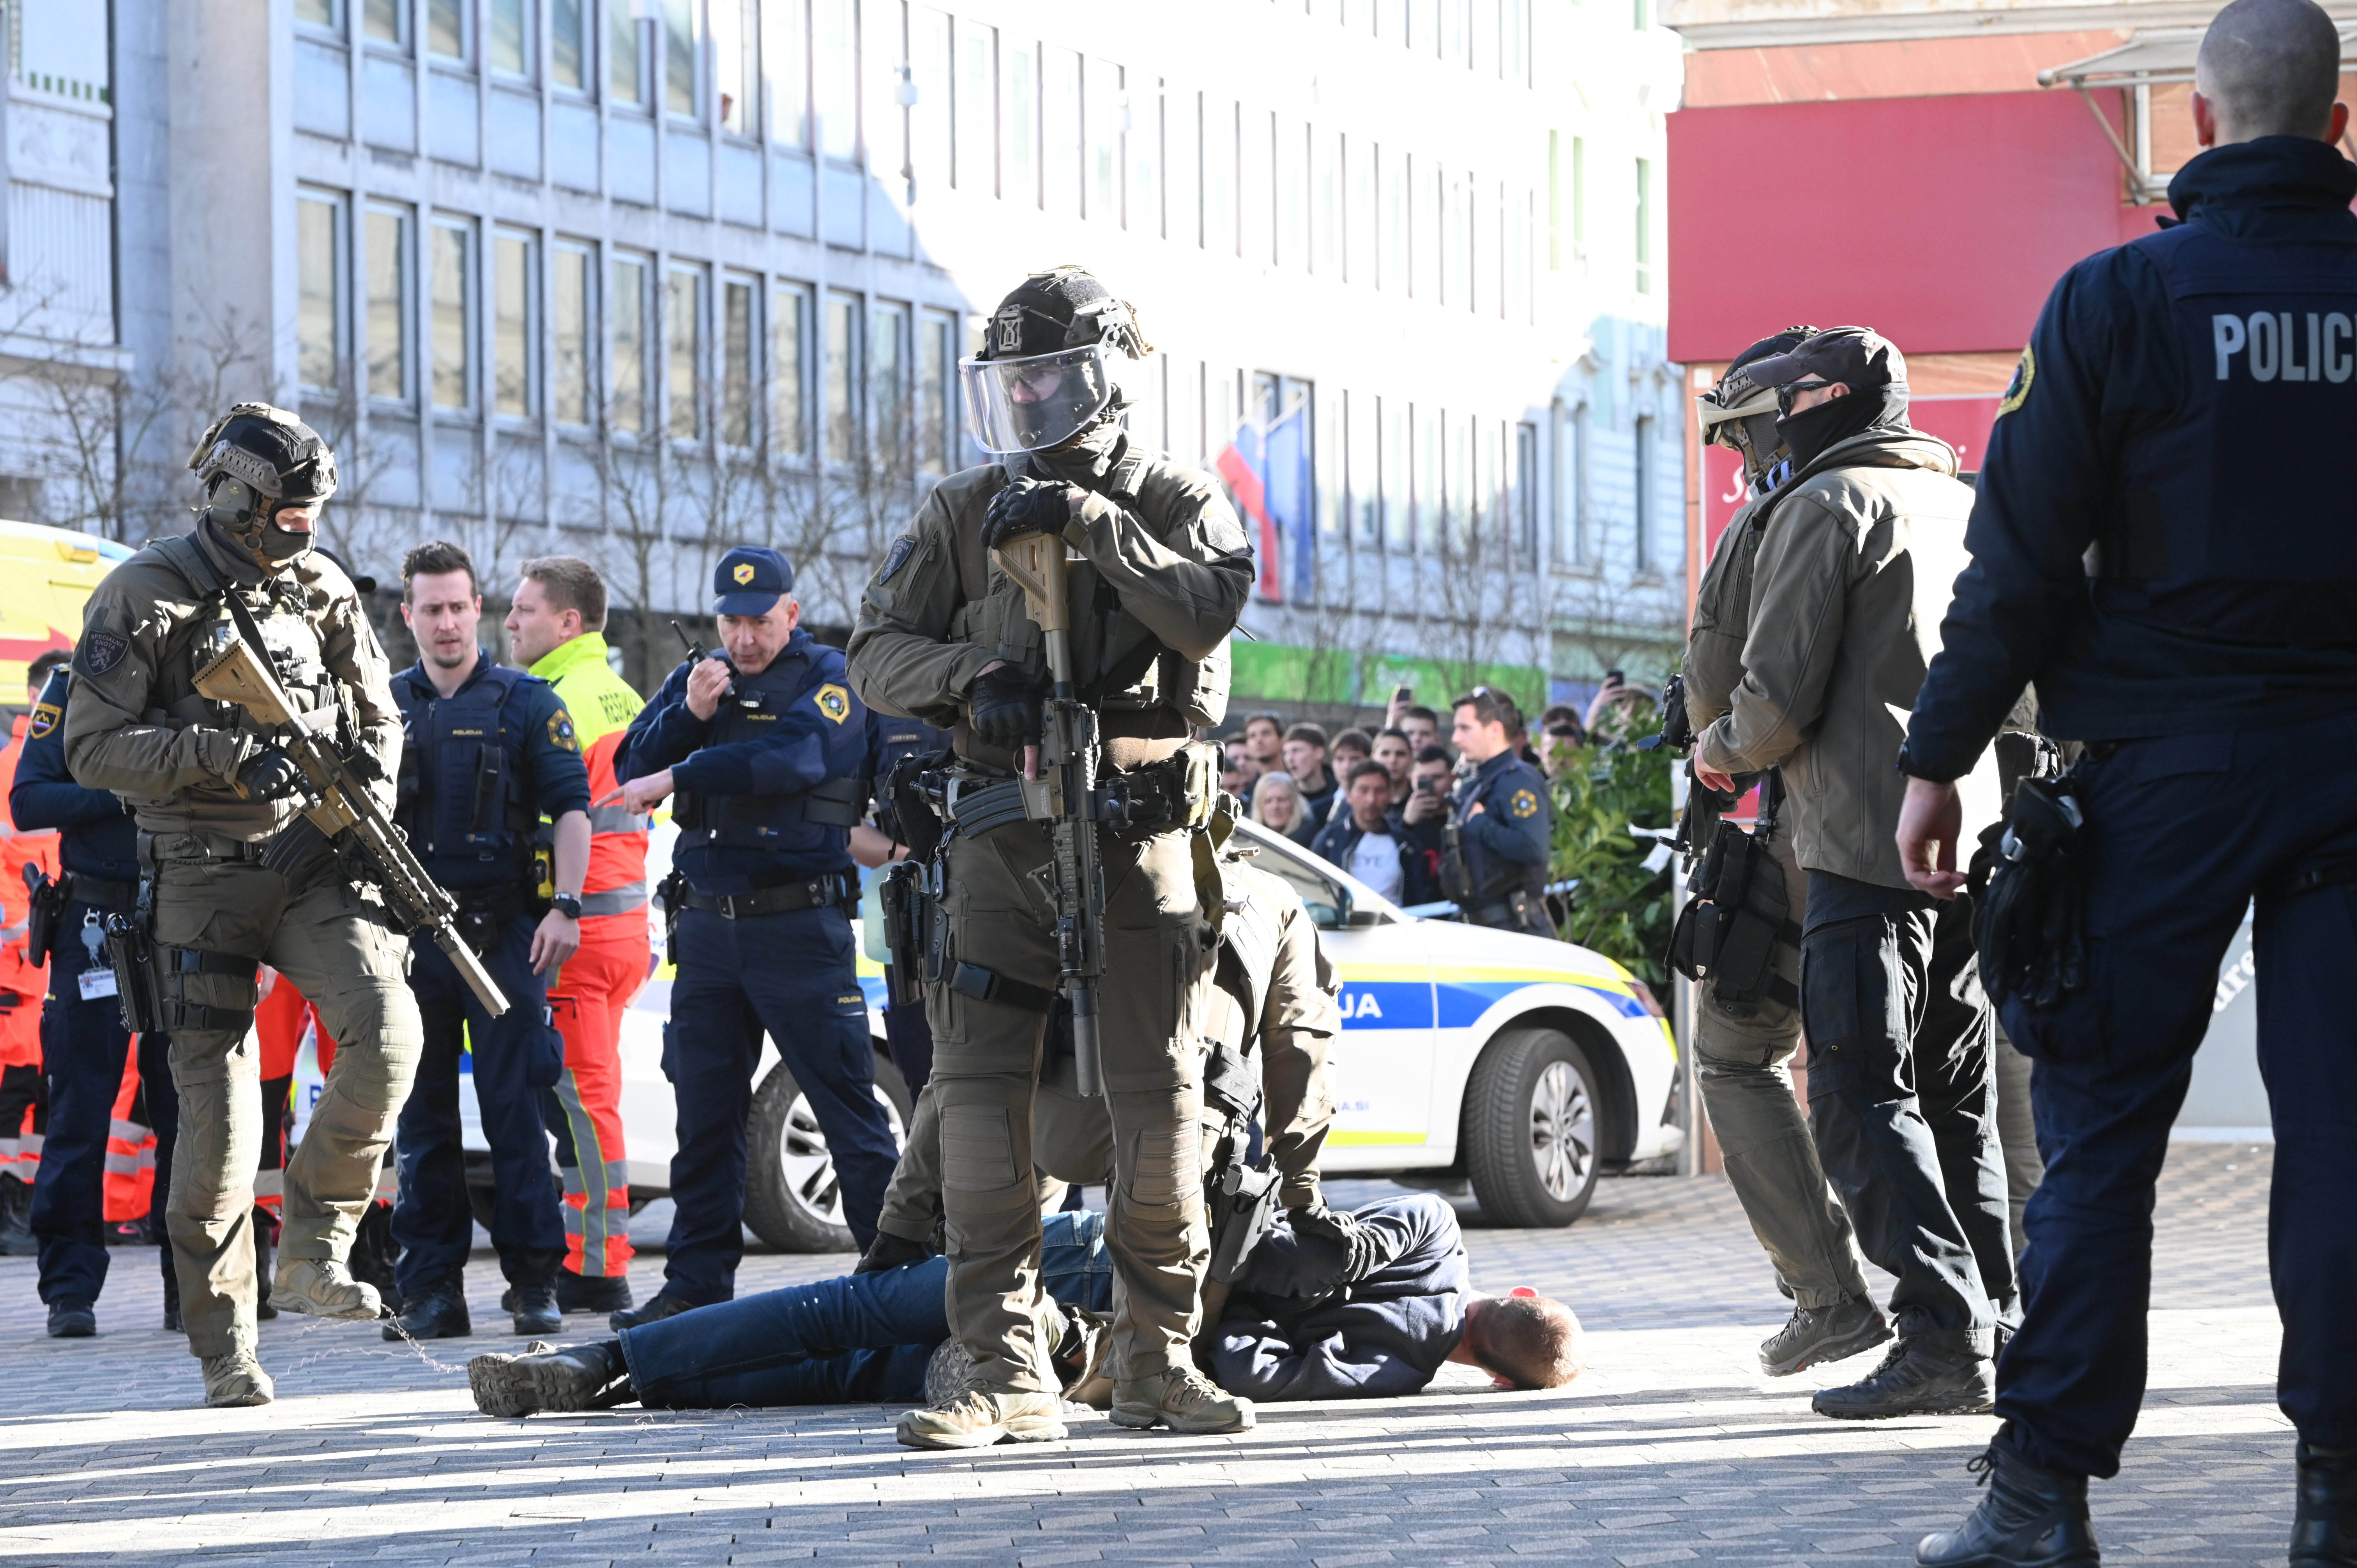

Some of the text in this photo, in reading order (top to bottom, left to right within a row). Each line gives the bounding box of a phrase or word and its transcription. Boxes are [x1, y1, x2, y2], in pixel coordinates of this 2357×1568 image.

[2212, 311, 2357, 383] POLIC
[91, 634, 124, 648] SPECIALNA
[95, 639, 115, 650] ENOTA
[1340, 993, 1383, 1018] JA
[310, 1085, 322, 1109] P
